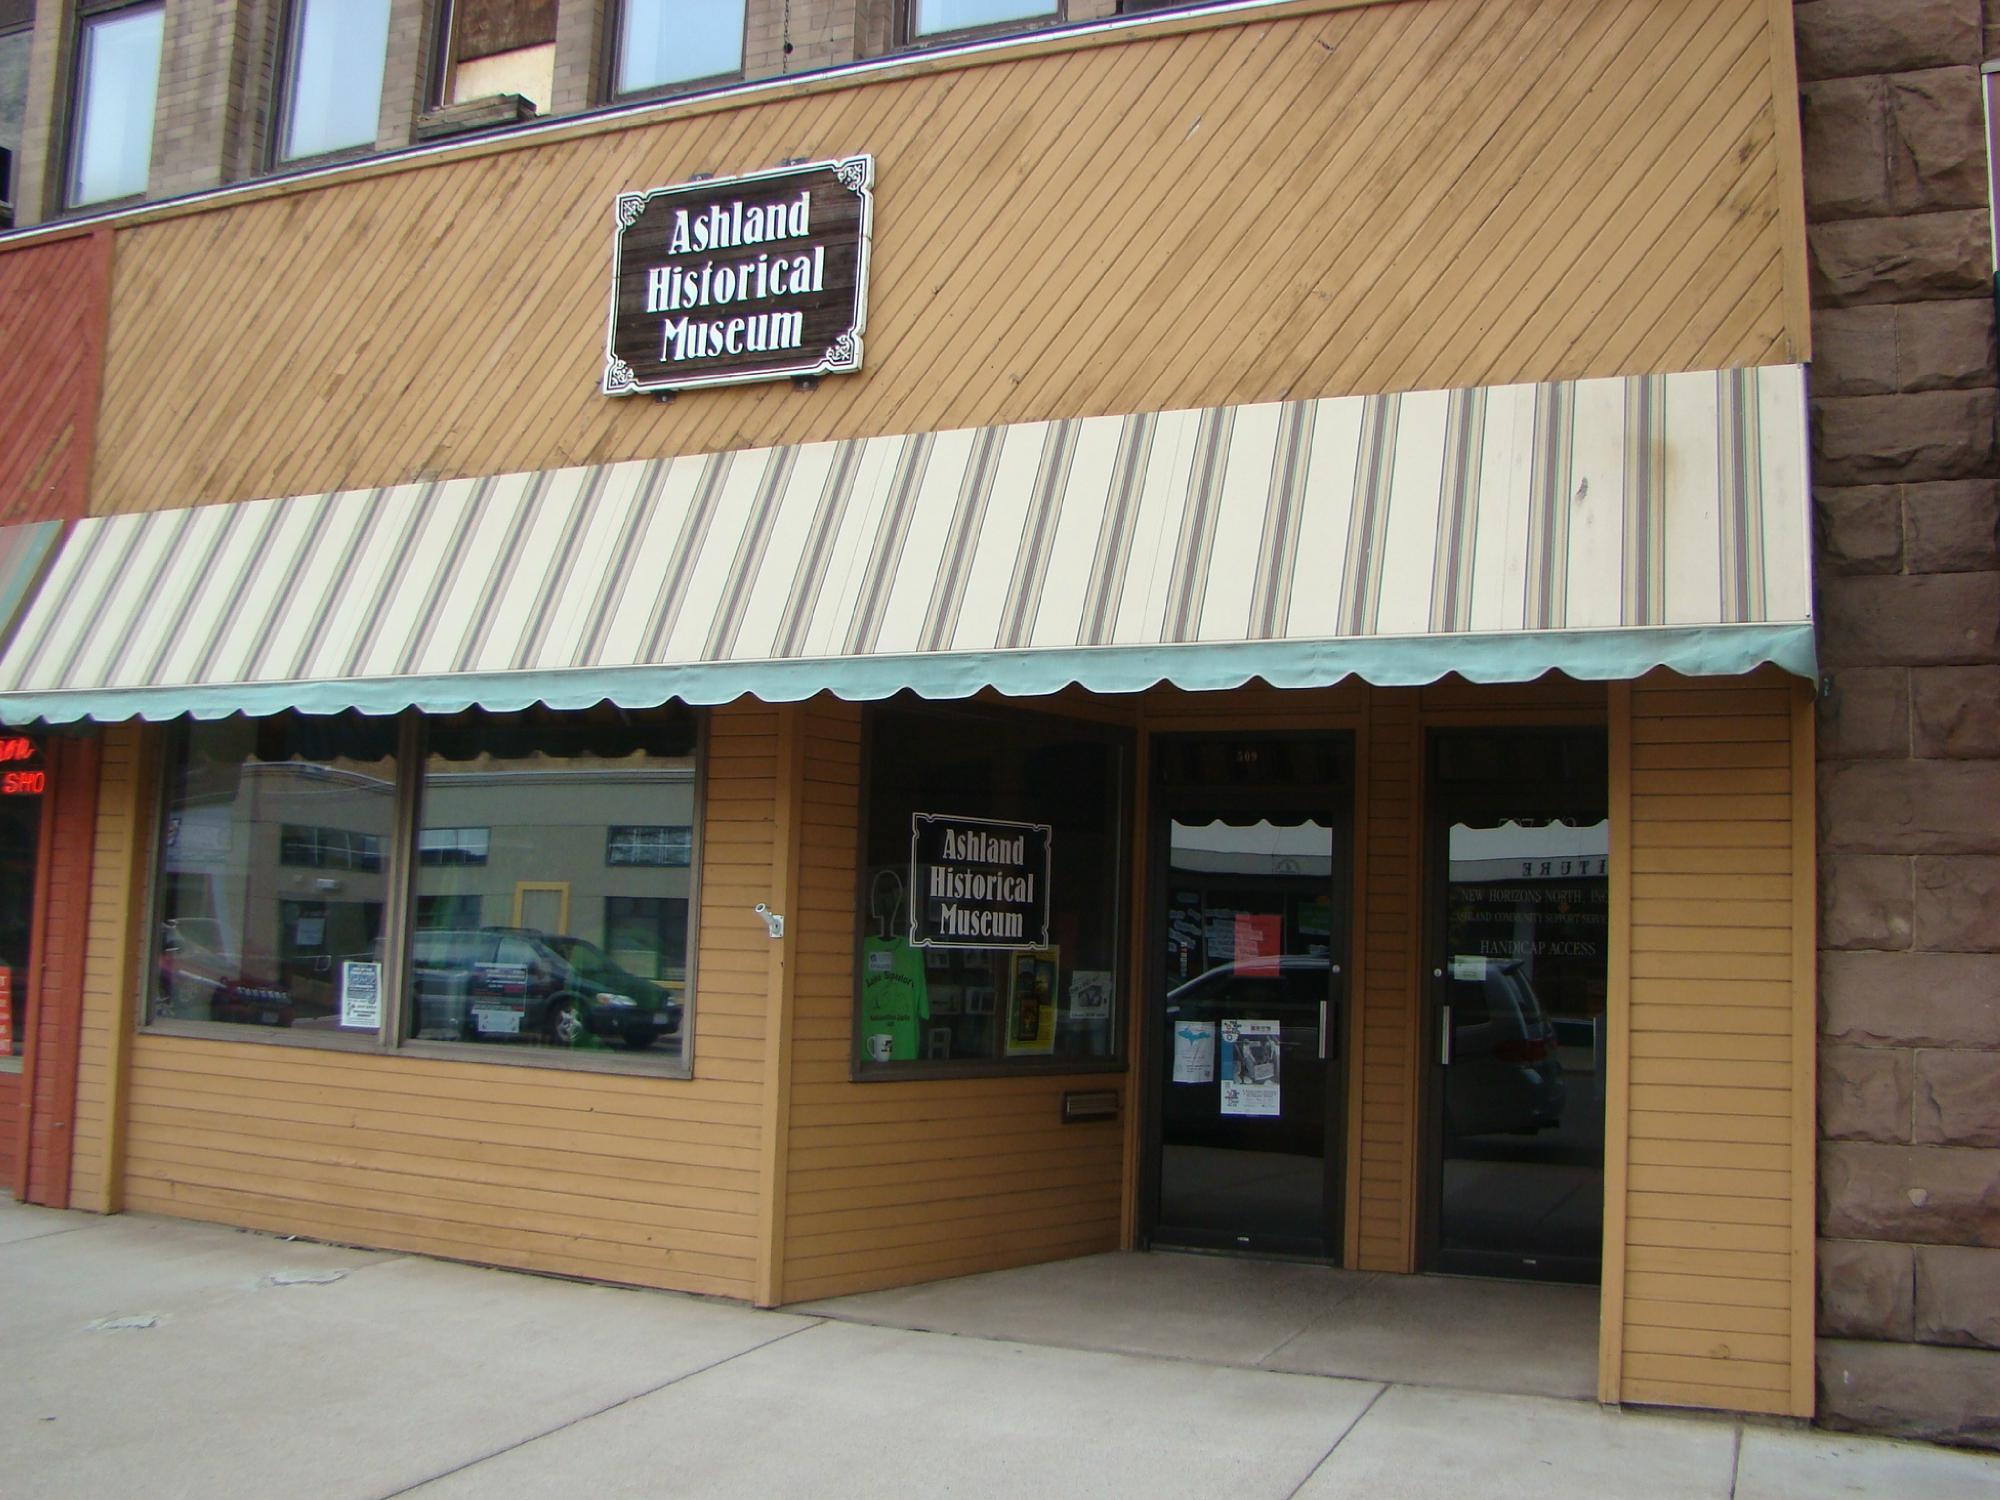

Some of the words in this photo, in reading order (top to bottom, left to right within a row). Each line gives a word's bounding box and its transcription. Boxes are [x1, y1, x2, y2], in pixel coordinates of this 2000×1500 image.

[669, 191, 811, 255] Ashland
[647, 246, 825, 313] Historical
[660, 311, 803, 362] Museum
[942, 828, 1024, 866] Ashland
[930, 866, 1034, 903] Historical
[1489, 888, 1542, 903] HORIZONS
[940, 903, 1023, 938] Museum
[1480, 939, 1546, 955] HANDICAP
[1548, 941, 1597, 956] ACCESS
